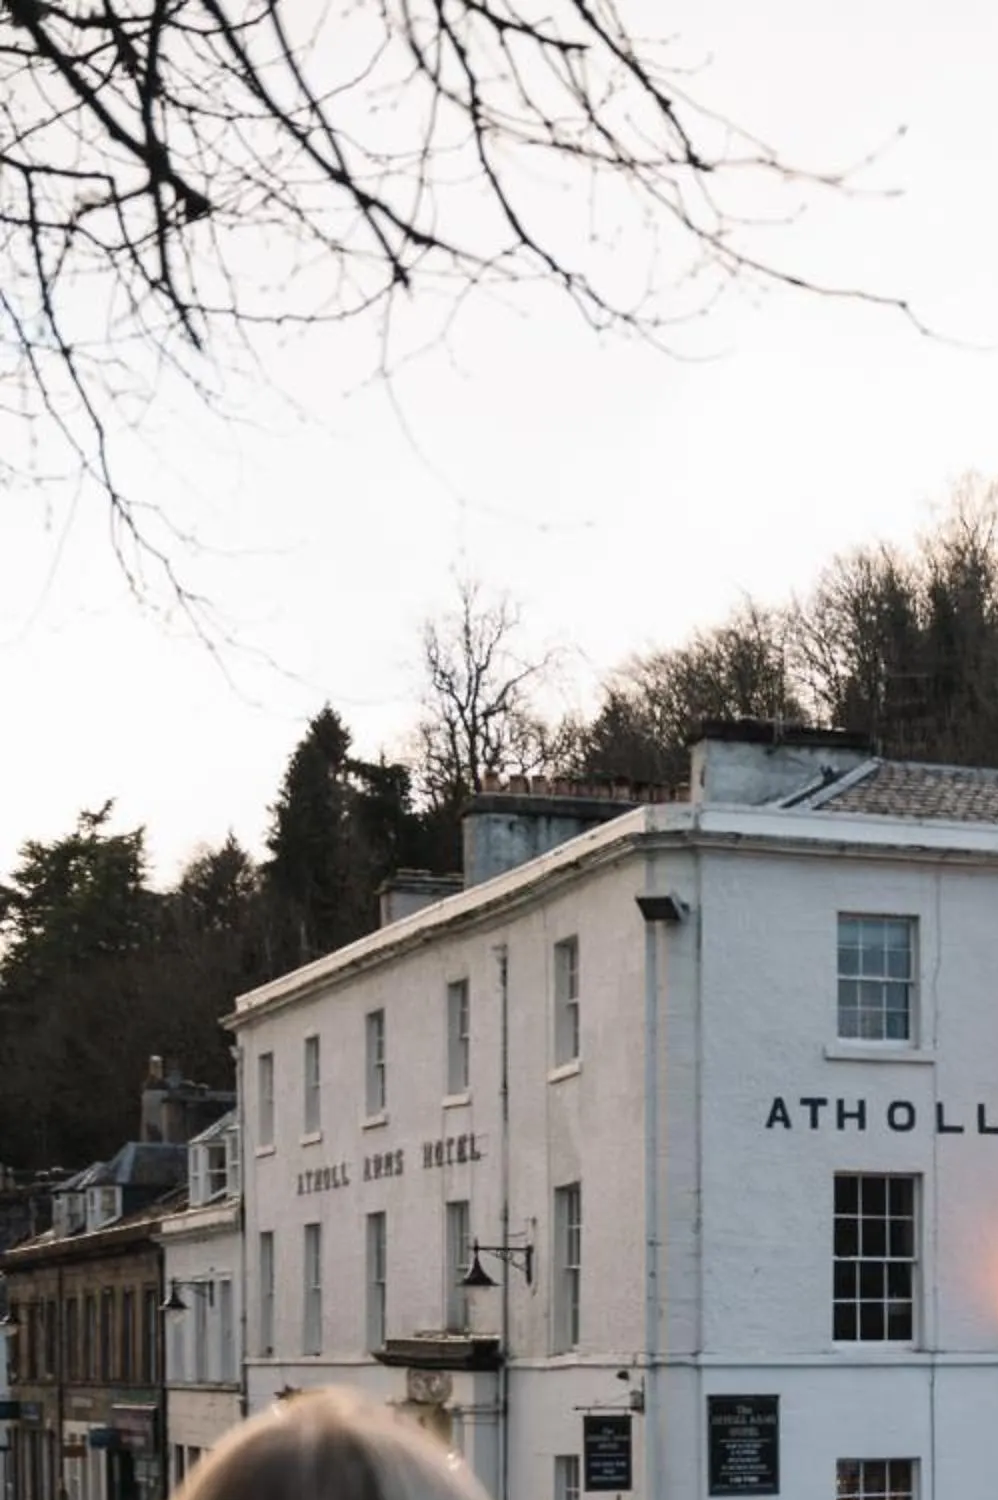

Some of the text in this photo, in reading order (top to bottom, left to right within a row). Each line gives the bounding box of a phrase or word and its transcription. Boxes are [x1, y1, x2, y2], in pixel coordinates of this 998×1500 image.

[297, 1133, 482, 1196] ATHOLL ARMS HOTEL
